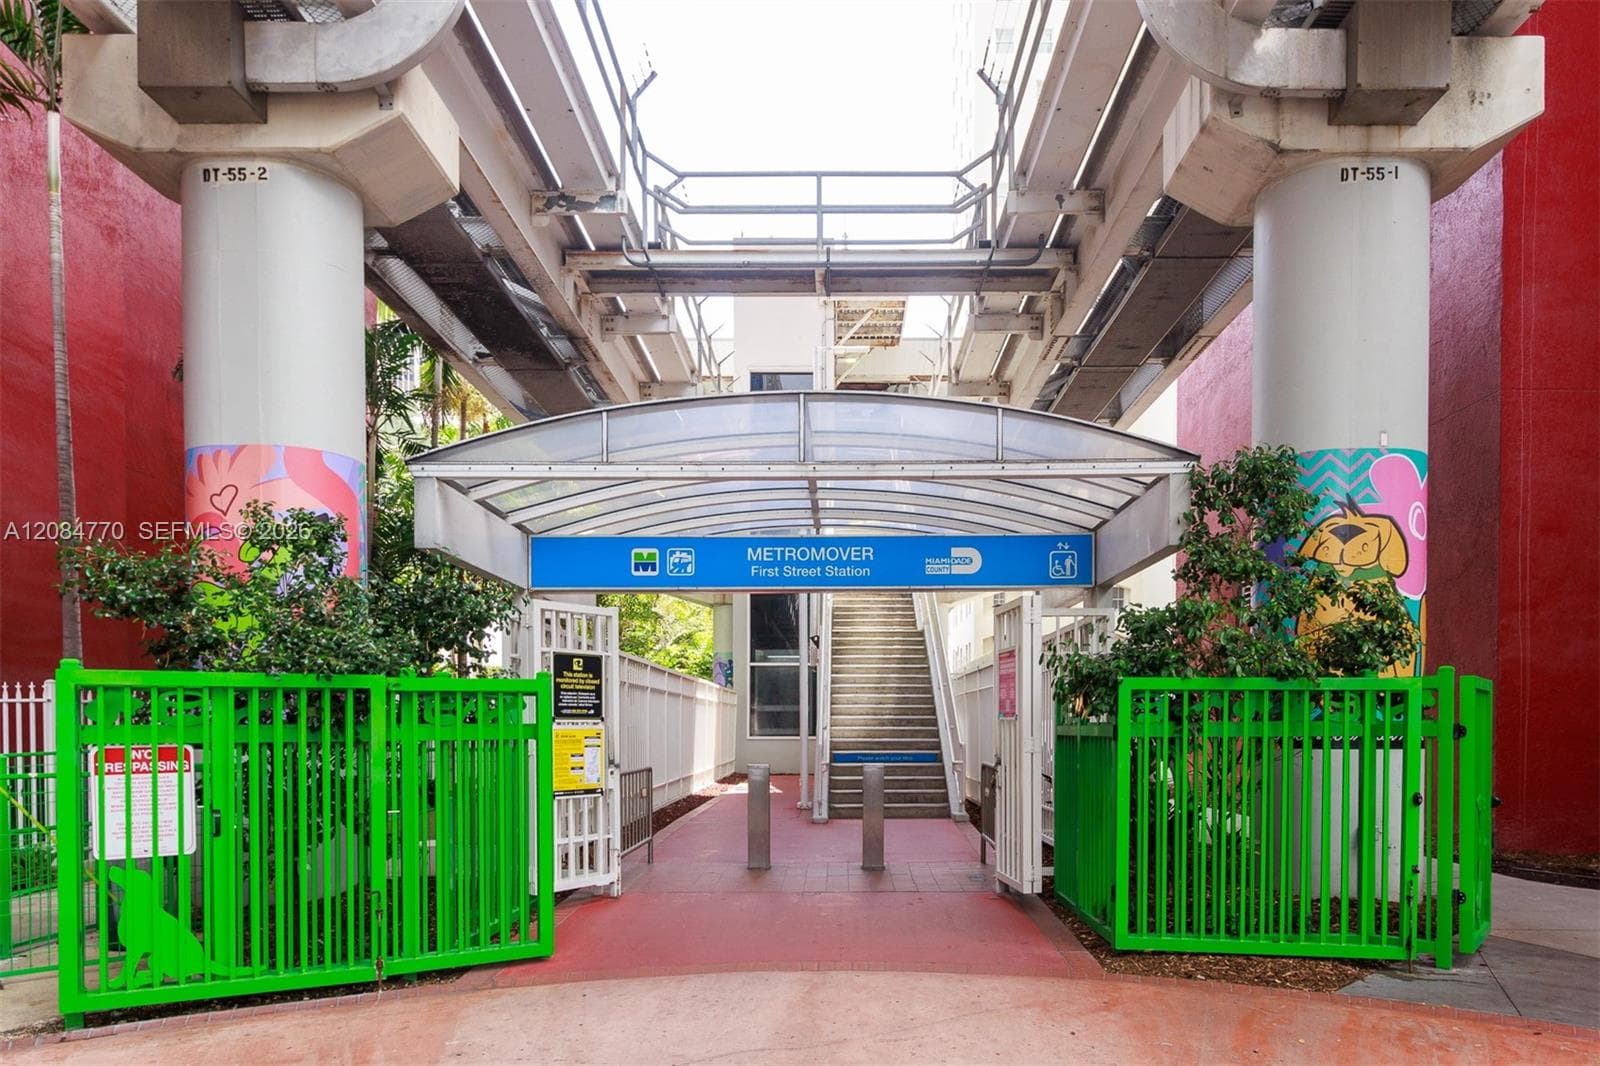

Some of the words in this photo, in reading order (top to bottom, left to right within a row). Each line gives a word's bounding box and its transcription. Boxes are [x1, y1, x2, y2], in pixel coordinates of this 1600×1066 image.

[203, 166, 268, 182] DT-55-2
[747, 547, 874, 561] METROMOVER
[751, 565, 779, 577] First
[783, 565, 821, 577] Street
[825, 565, 871, 577] Station
[131, 749, 154, 760] NO
[95, 761, 190, 773] REPASING
